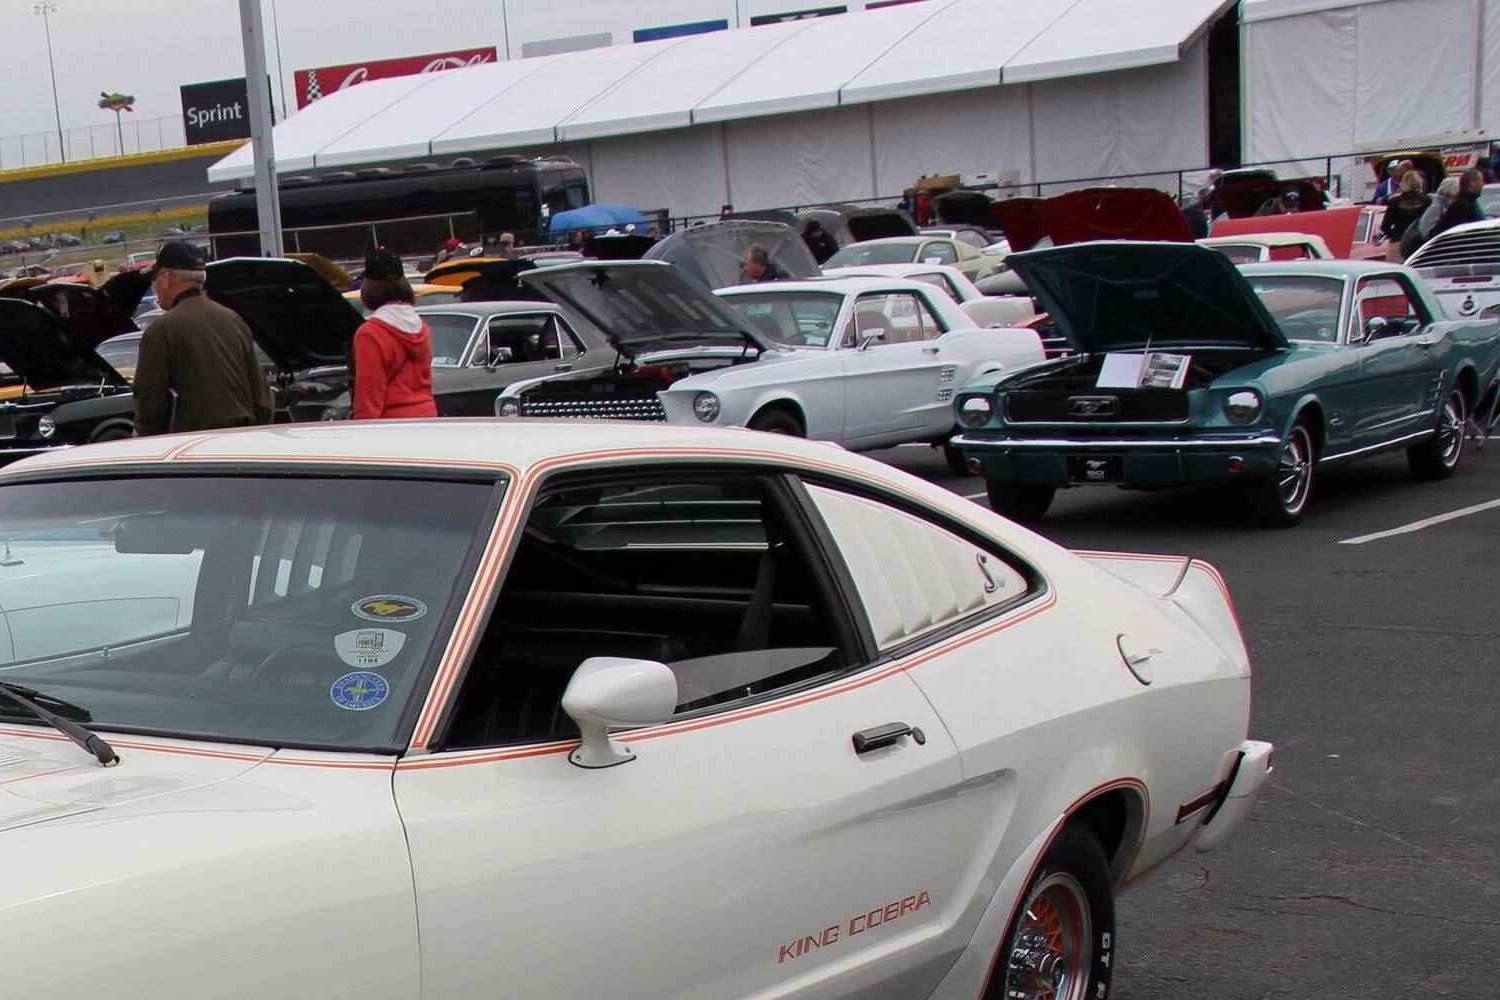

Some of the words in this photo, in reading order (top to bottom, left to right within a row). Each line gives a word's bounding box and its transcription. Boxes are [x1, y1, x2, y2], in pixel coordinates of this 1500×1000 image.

[187, 102, 243, 128] Sprint
[778, 925, 840, 964] KING
[849, 890, 932, 937] COBRA
[1101, 932, 1111, 968] GT
